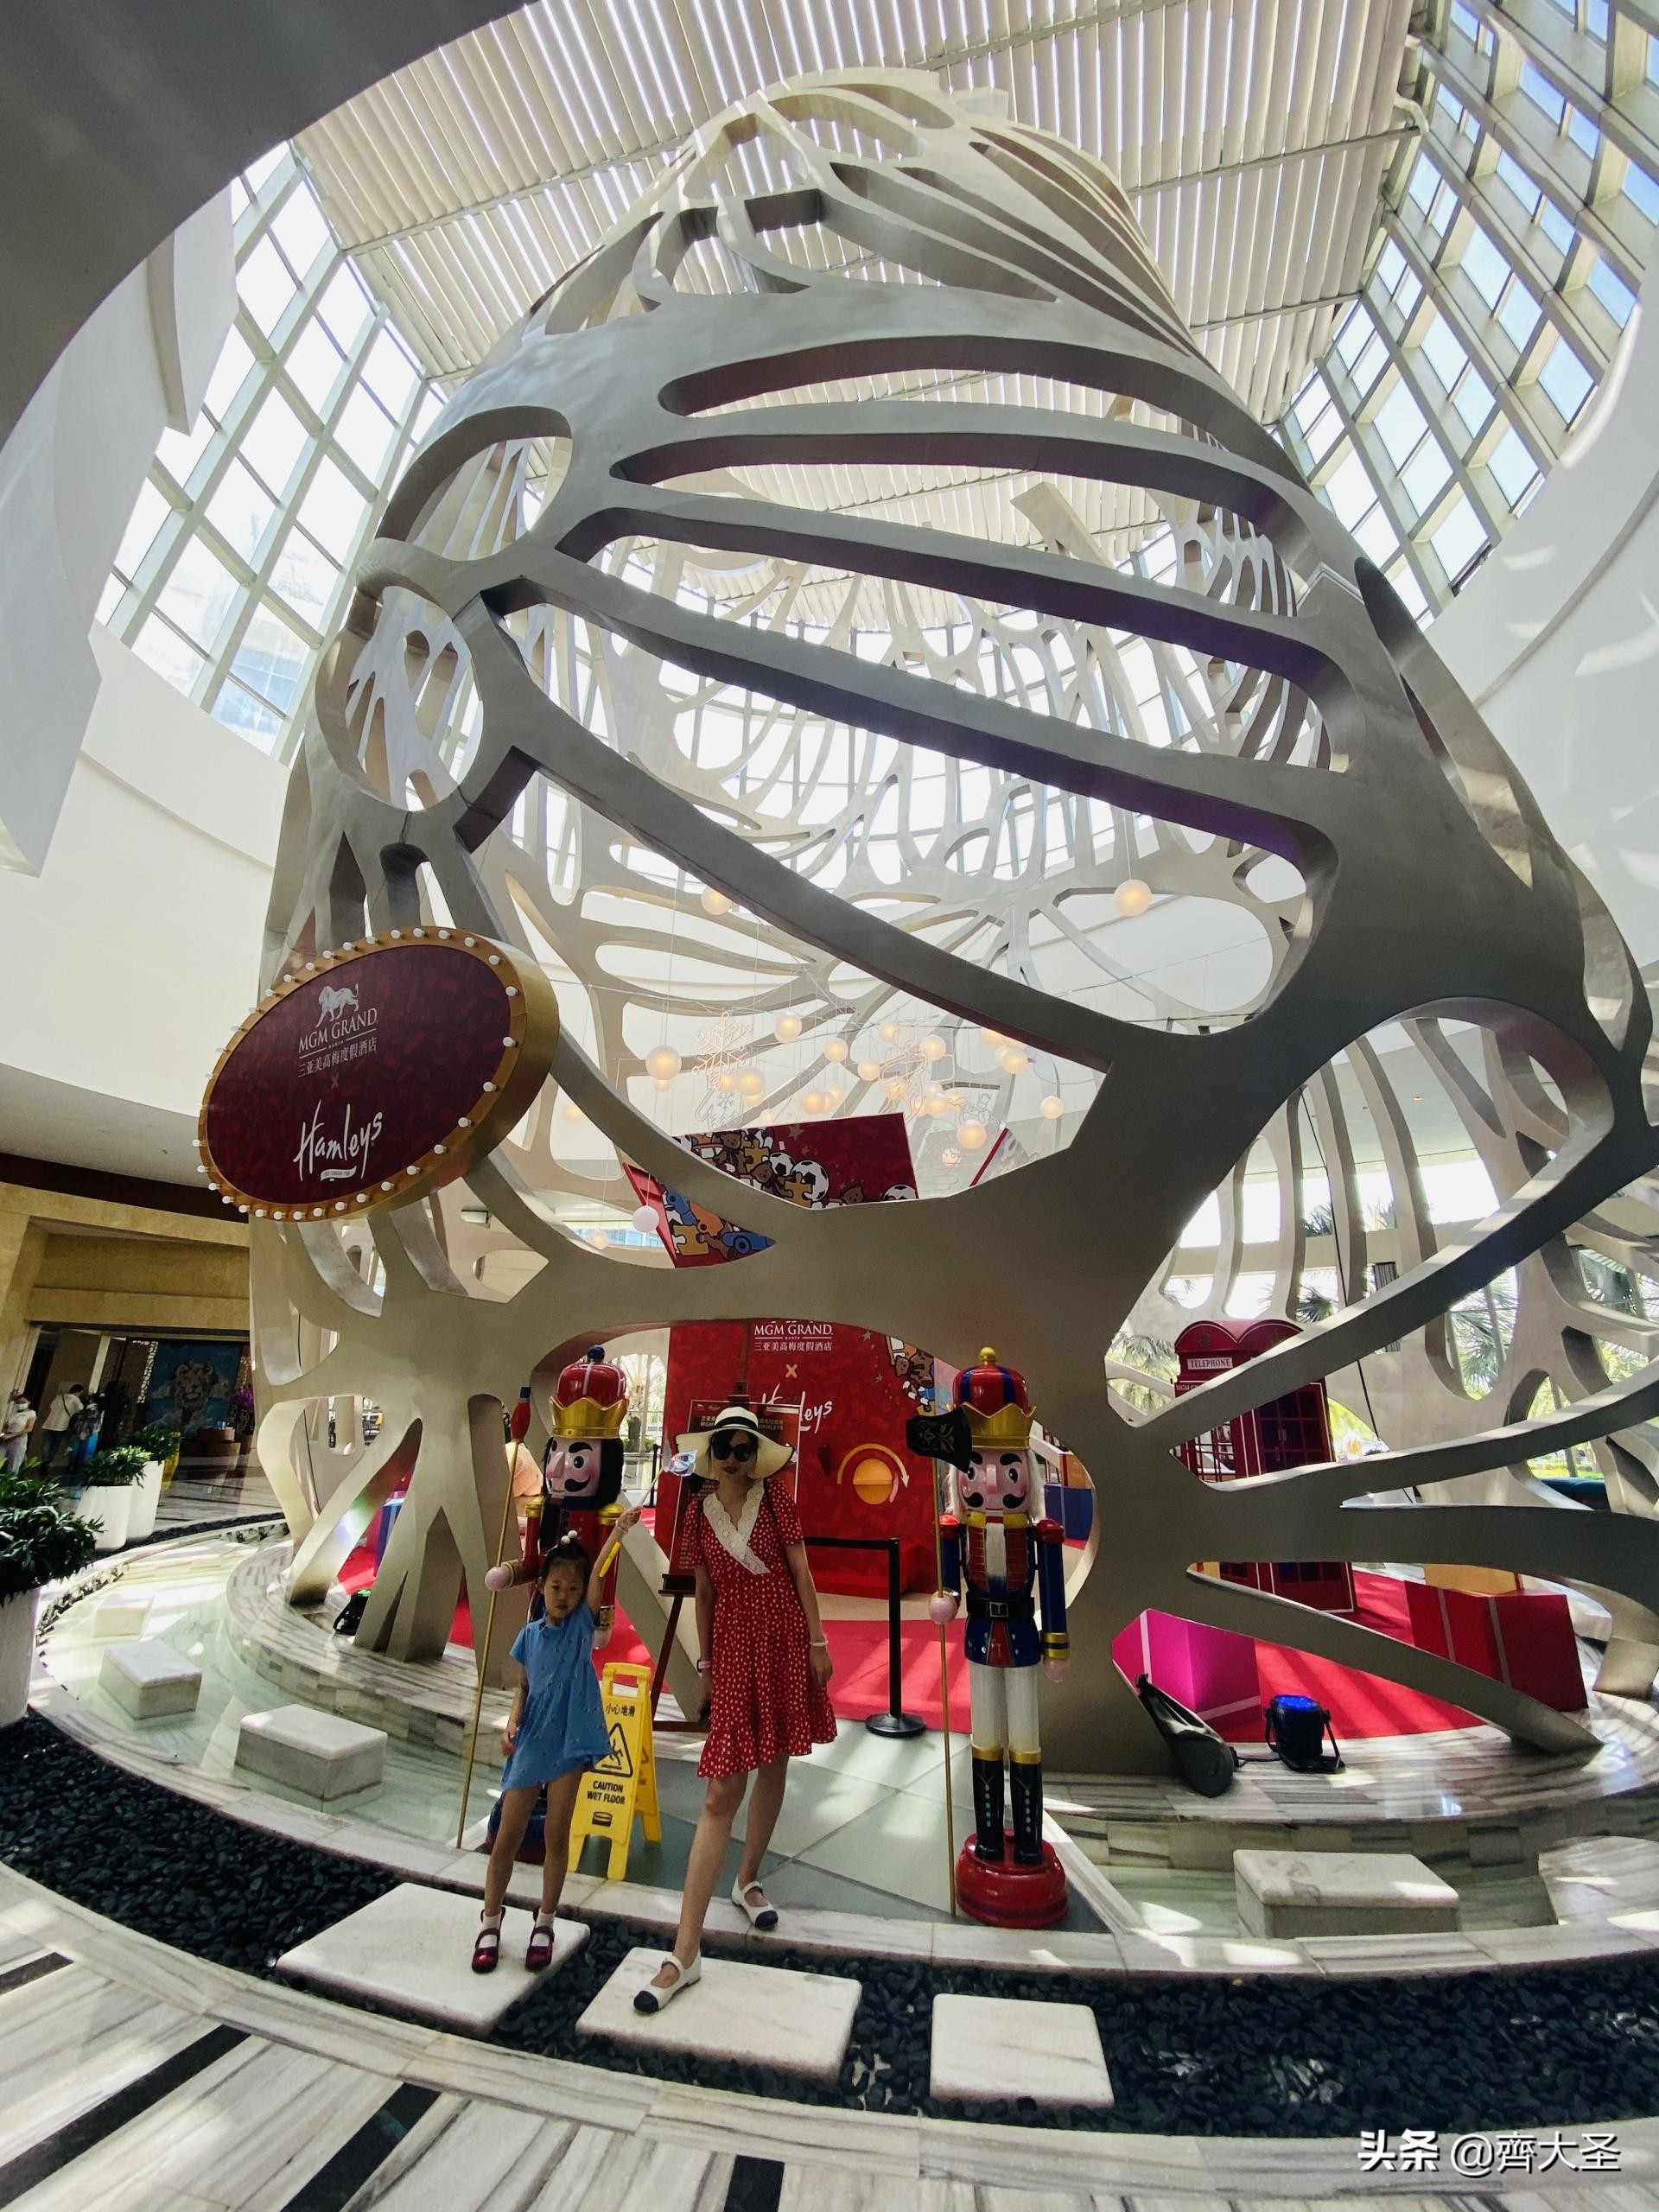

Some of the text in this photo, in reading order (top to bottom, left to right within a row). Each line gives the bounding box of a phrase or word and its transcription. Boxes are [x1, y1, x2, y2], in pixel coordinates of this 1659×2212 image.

[298, 1007, 378, 1053] MGM GRAND
[298, 1037, 378, 1077] 三亚美高梅度假酒店
[293, 1099, 383, 1181] Hamleys
[753, 1324, 832, 1335] MGM GRAND
[753, 1341, 832, 1351] 三亚美高梅度假酒店
[1191, 1358, 1230, 1368] TELEPHONE
[606, 1703, 635, 1718] 小心地滑
[593, 1780, 624, 1793] CAUTION
[587, 1790, 626, 1805] WET FLOOR
